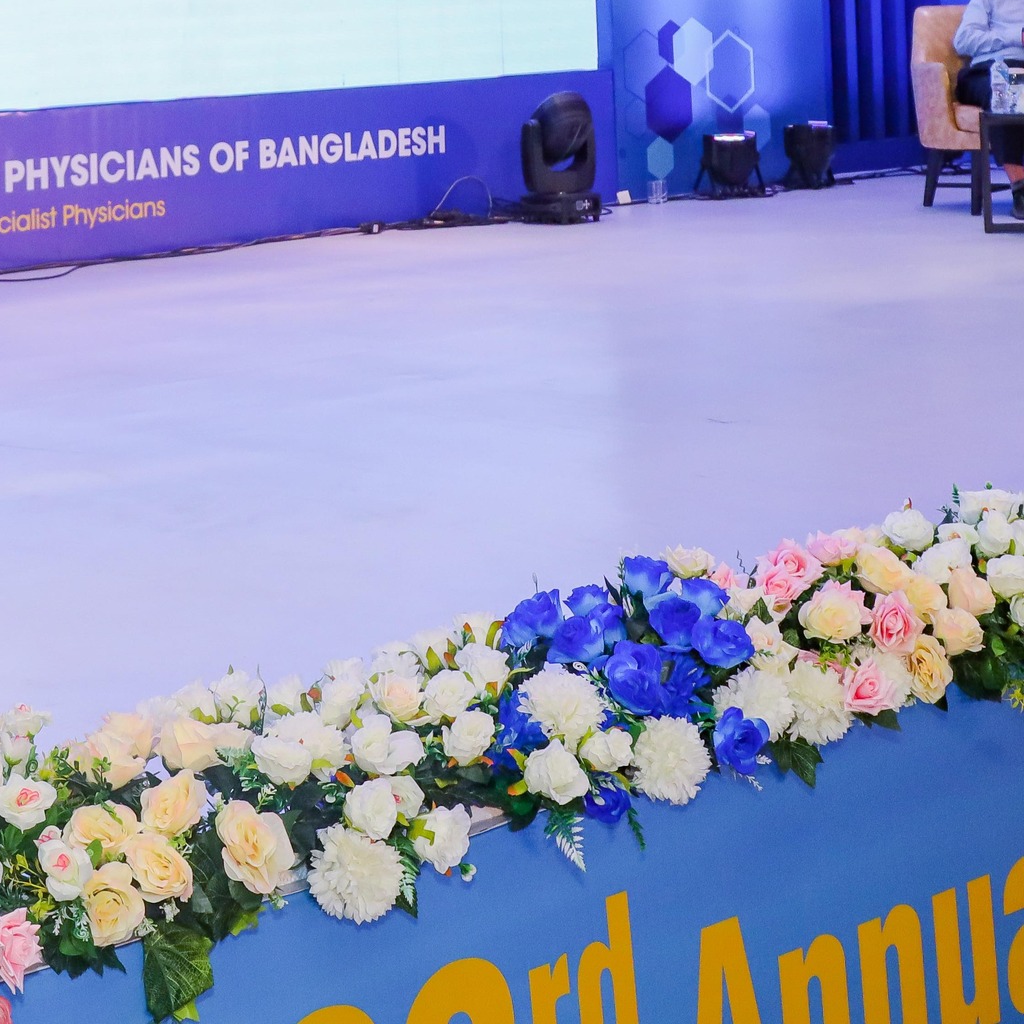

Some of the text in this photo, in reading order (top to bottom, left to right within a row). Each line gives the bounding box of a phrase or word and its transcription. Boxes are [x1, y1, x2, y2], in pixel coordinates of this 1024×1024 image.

[5, 144, 200, 193] PHYSICIANS
[209, 141, 249, 174] OF
[259, 125, 446, 168] BANGLADESH
[64, 197, 166, 229] Physicians
